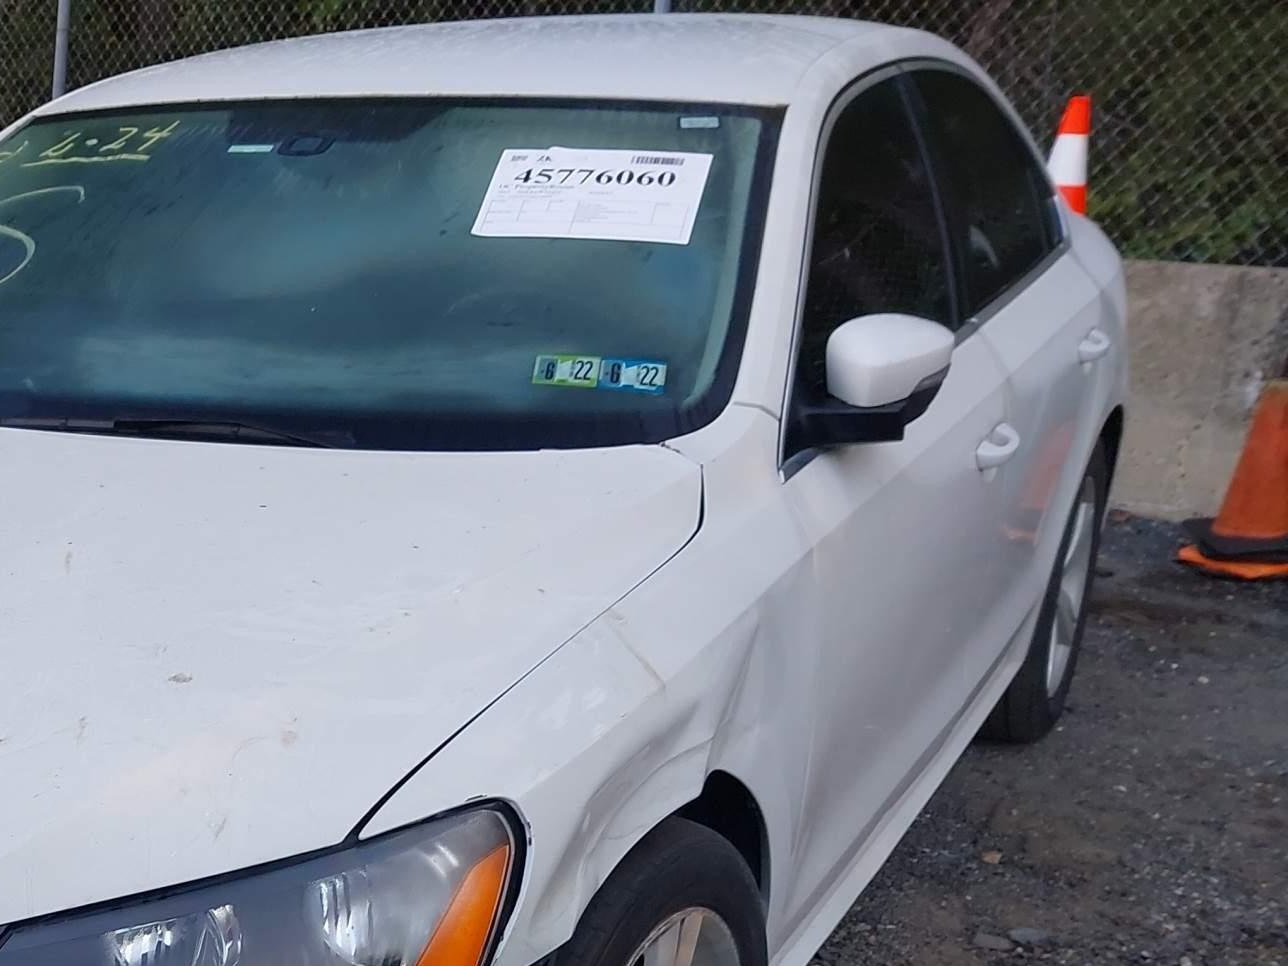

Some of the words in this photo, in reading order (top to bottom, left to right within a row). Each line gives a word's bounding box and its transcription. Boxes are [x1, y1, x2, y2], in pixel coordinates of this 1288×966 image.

[514, 168, 676, 187] 45776060
[574, 360, 594, 380] 22
[640, 365, 659, 386] 22
